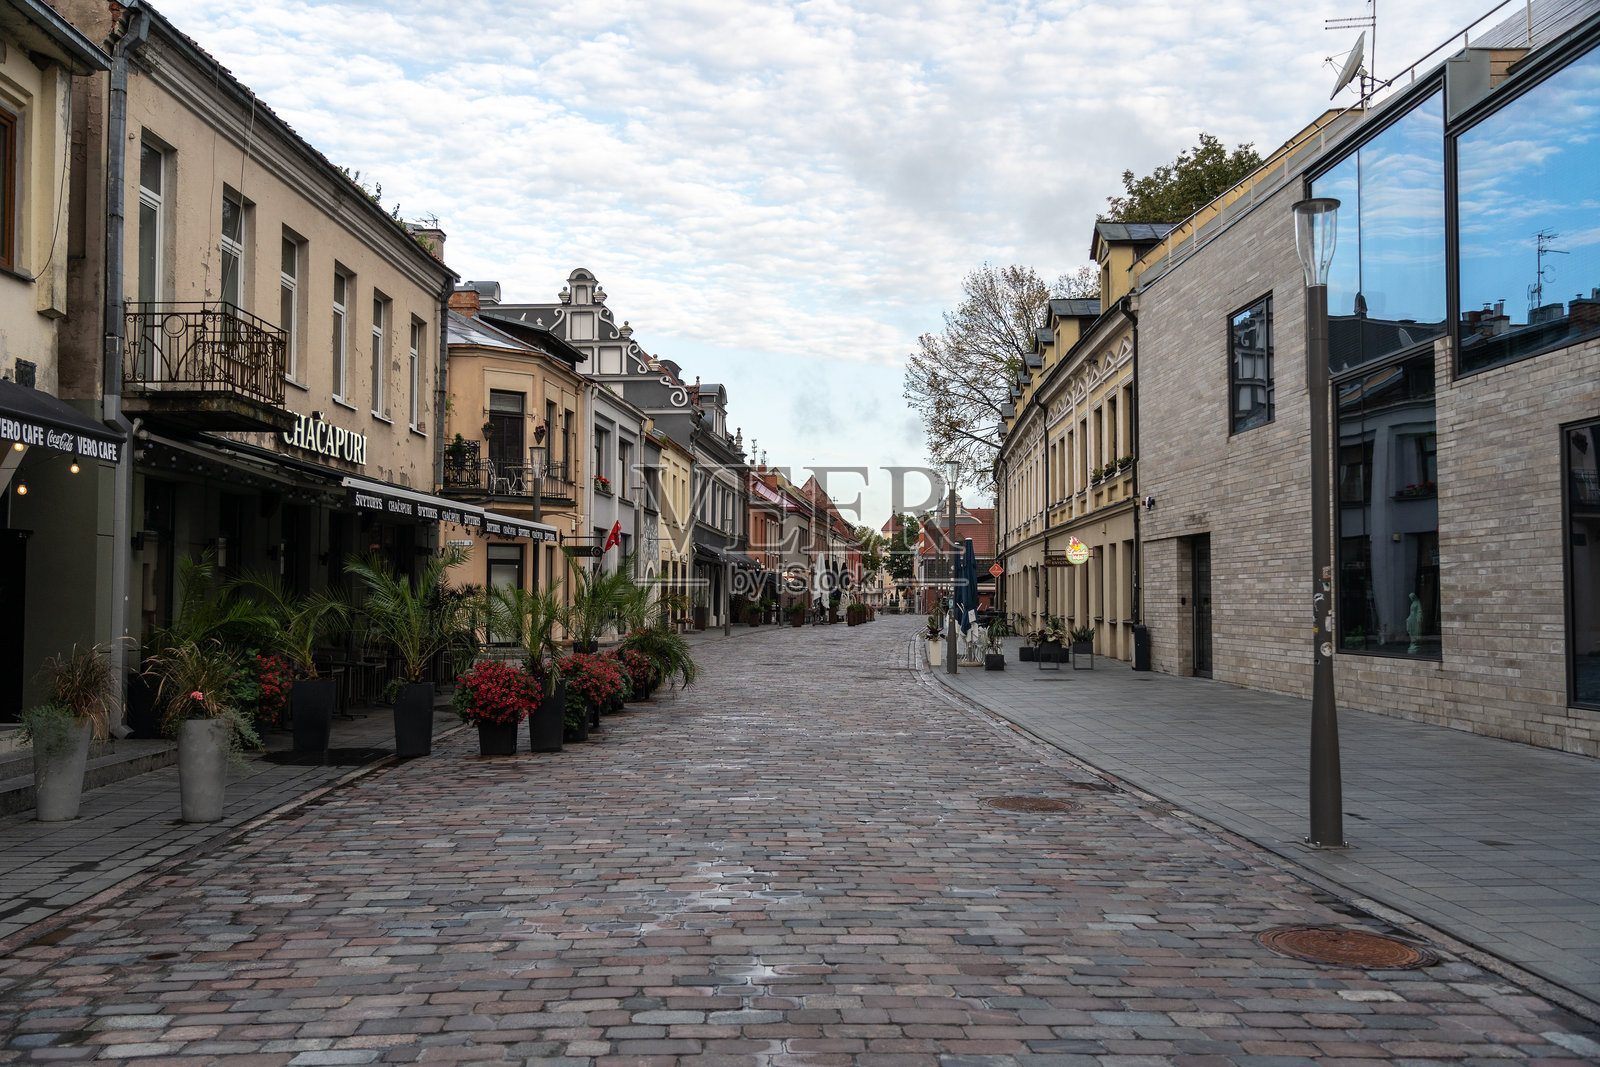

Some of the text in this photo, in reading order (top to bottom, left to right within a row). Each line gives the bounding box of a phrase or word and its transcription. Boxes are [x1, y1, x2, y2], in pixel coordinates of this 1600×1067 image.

[0, 418, 20, 441] ERO
[22, 423, 44, 446] CAFE
[77, 435, 97, 457] VERO
[98, 441, 117, 461] CAFE
